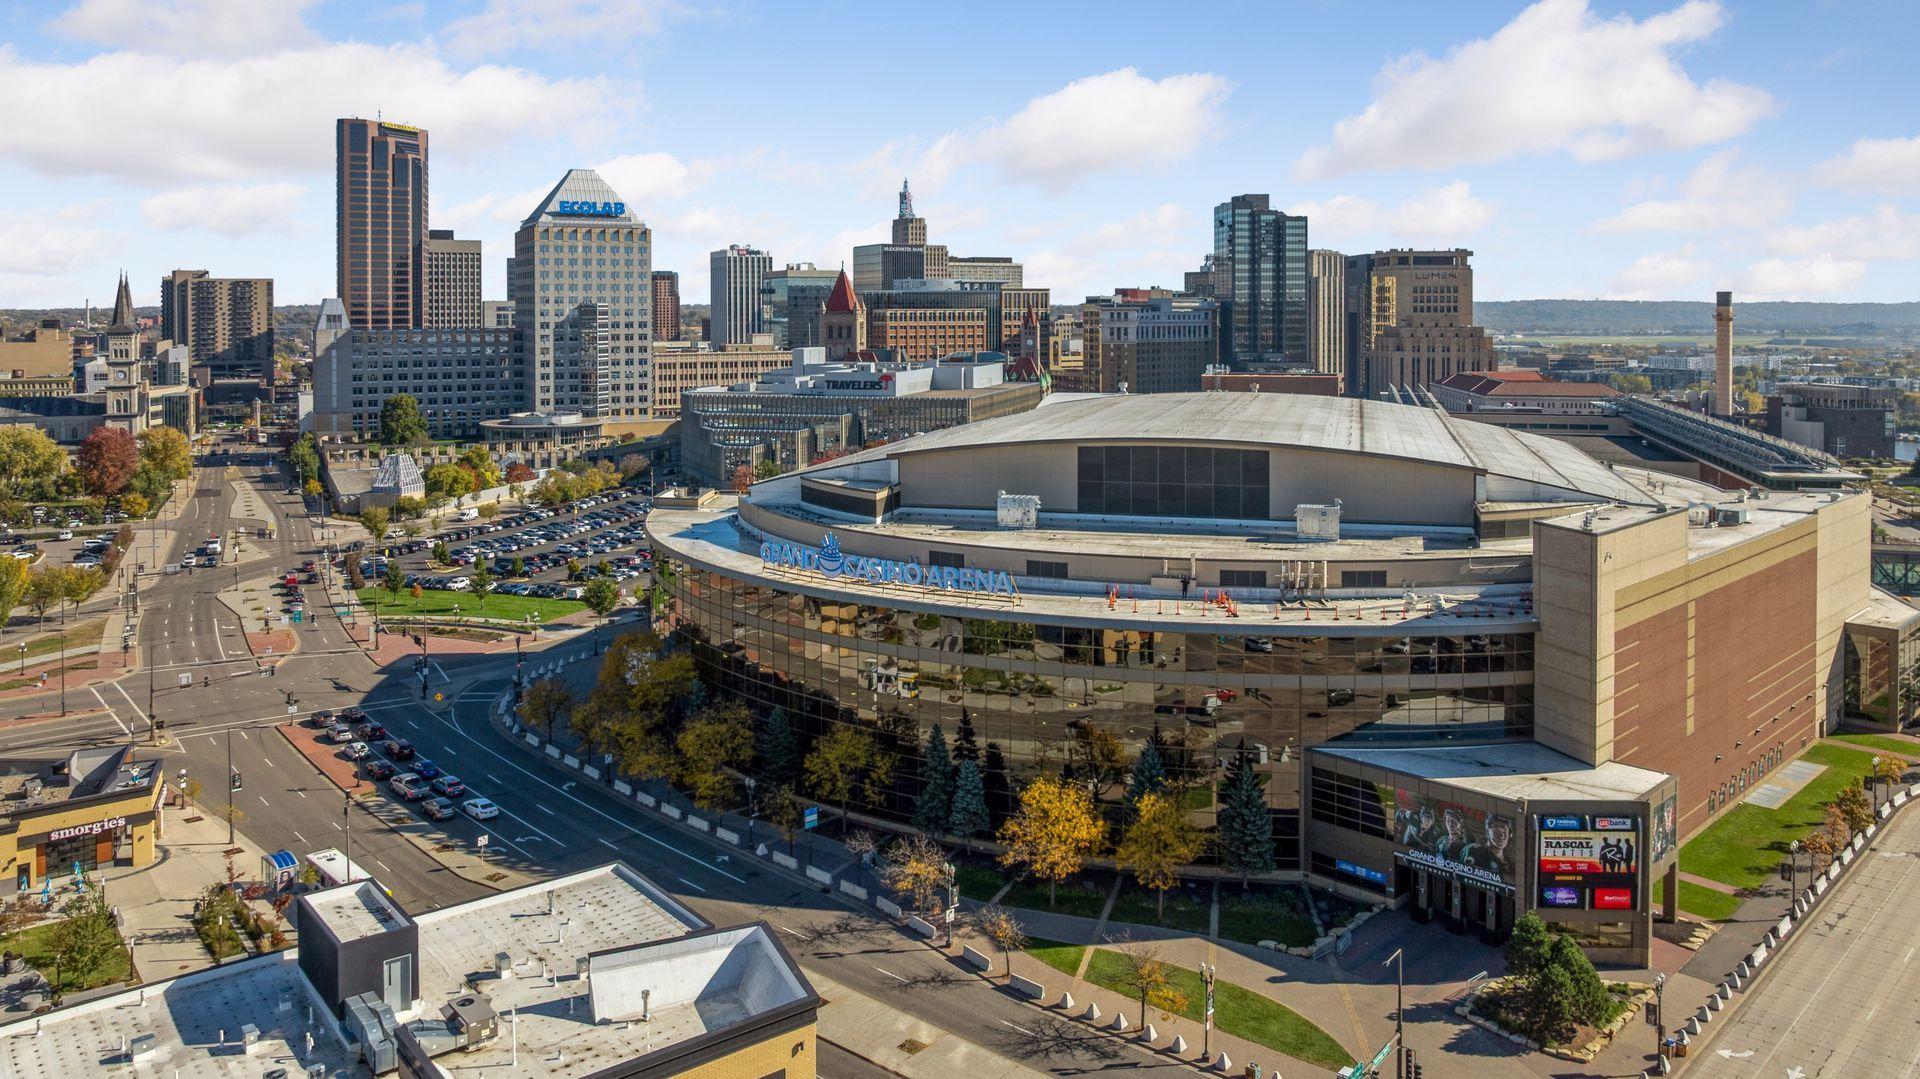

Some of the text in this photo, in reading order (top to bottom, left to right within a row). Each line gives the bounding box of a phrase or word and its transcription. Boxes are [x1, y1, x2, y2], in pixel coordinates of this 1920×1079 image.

[559, 200, 625, 215] ECOLAB
[825, 380, 883, 390] TRAVELERS
[760, 541, 1015, 595] GRAND CASINO ARENA
[49, 815, 126, 841] smorgie's
[1544, 841, 1593, 849] RASCAL
[1409, 849, 1502, 882] GRAND CASINO ARENA
[1411, 863, 1450, 876] SOUTHWEST
[1464, 878, 1500, 892] ENTRANCE
